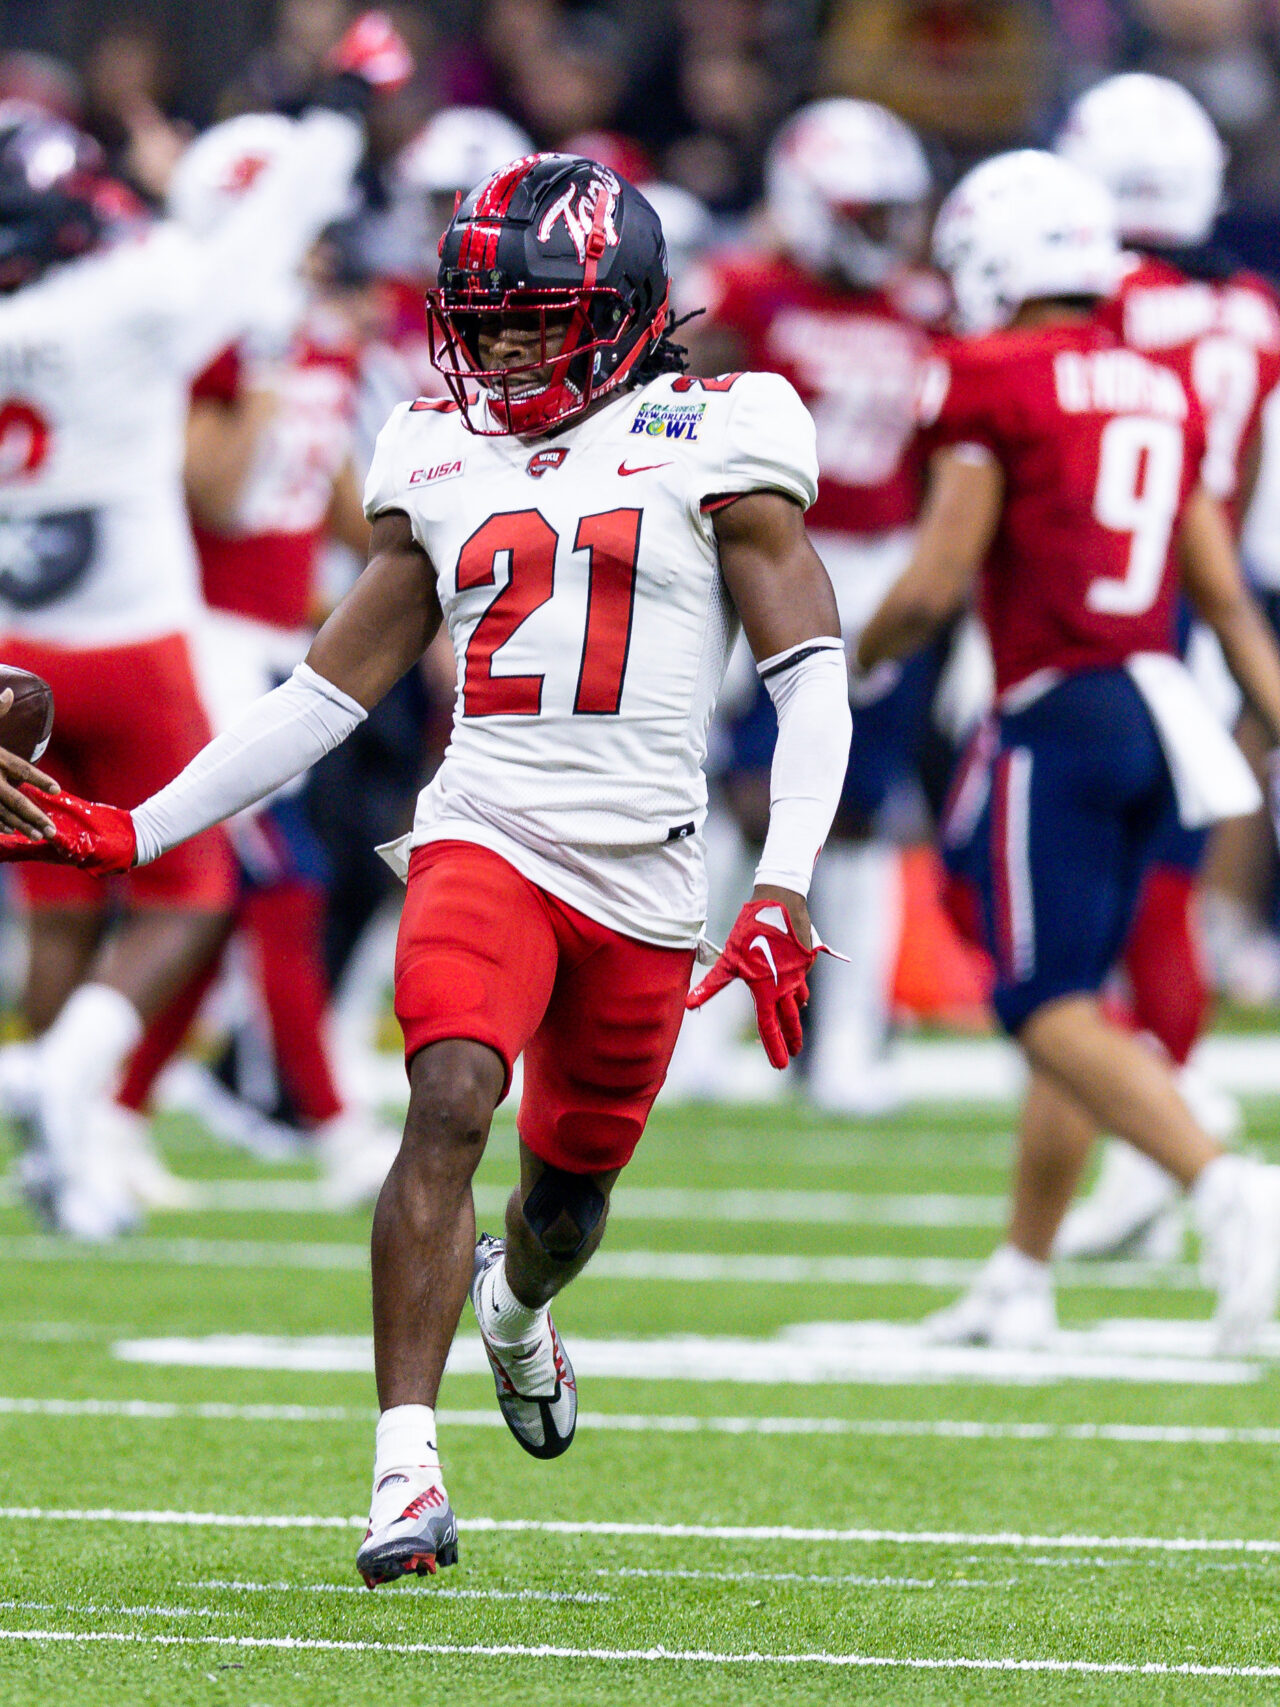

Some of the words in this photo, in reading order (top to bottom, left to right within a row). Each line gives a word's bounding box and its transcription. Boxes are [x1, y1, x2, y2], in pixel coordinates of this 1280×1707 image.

[629, 417, 698, 441] BOWL
[636, 409, 660, 419] NEW
[661, 411, 704, 422] ORLEANS
[1085, 414, 1184, 616] 9
[455, 507, 645, 718] 21
